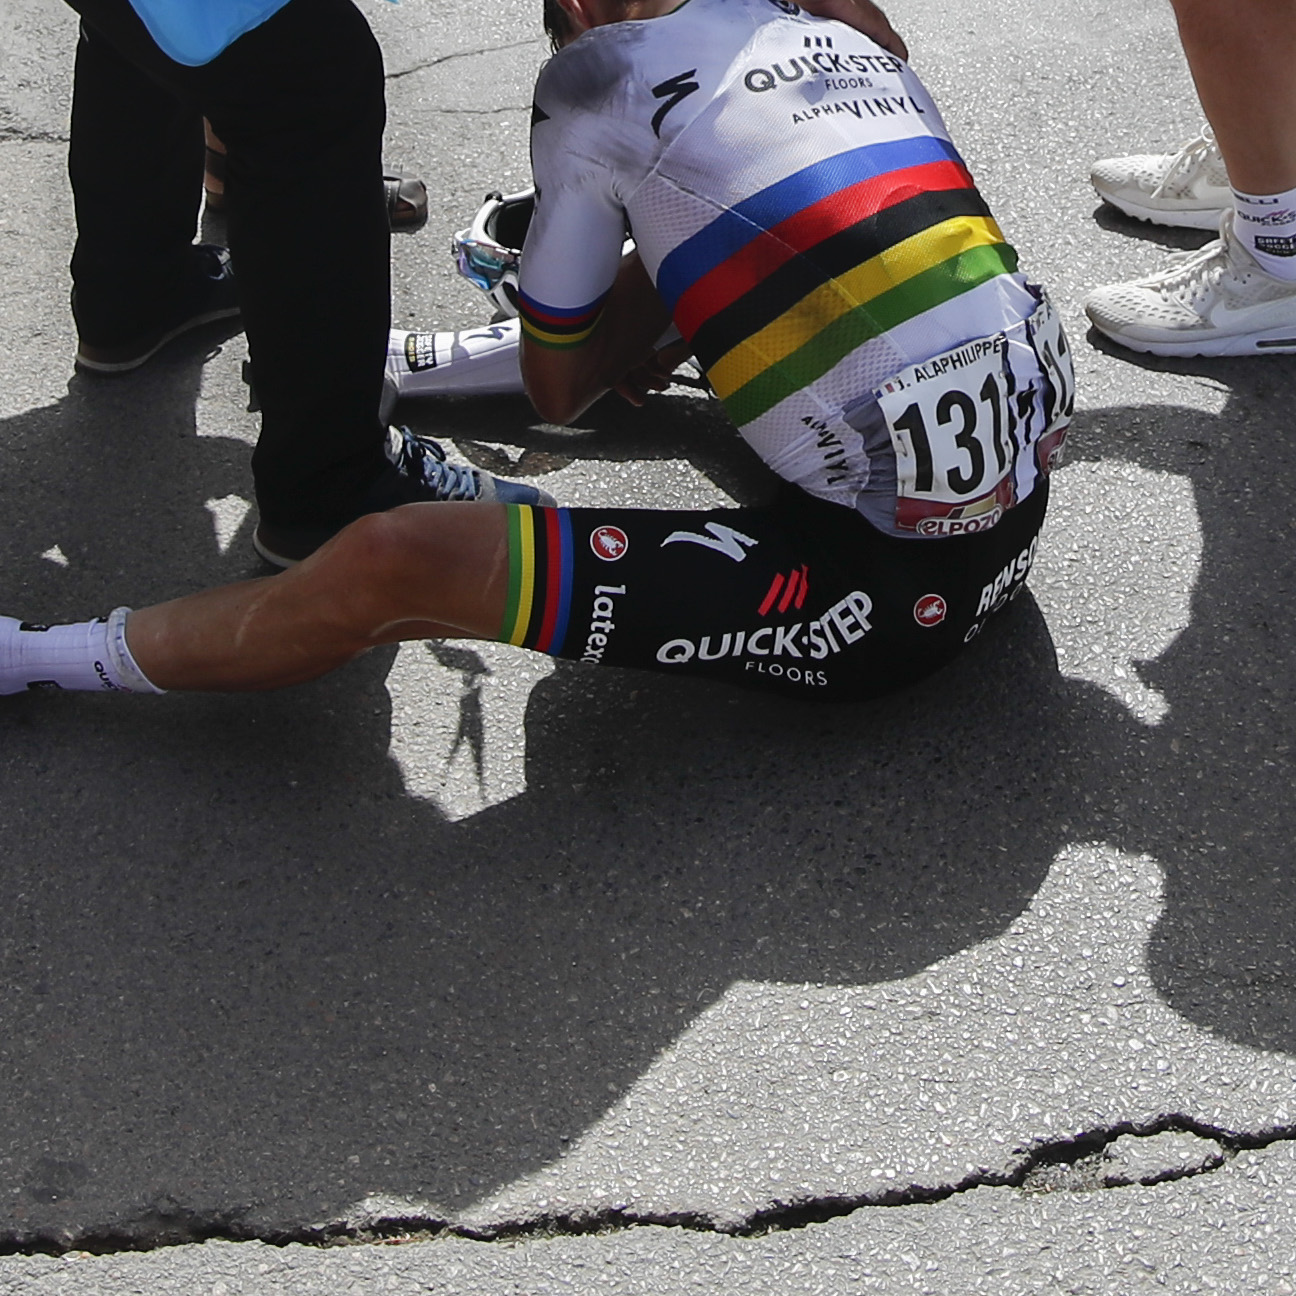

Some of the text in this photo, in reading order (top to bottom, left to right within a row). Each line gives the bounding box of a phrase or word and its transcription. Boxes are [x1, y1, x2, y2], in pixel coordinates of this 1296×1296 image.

[824, 77, 873, 91] FLOORS
[914, 337, 1001, 383] ALAPHILIPPE
[893, 372, 1006, 495] 131
[975, 526, 1045, 617] RENSO
[745, 661, 828, 686] FLOORS
